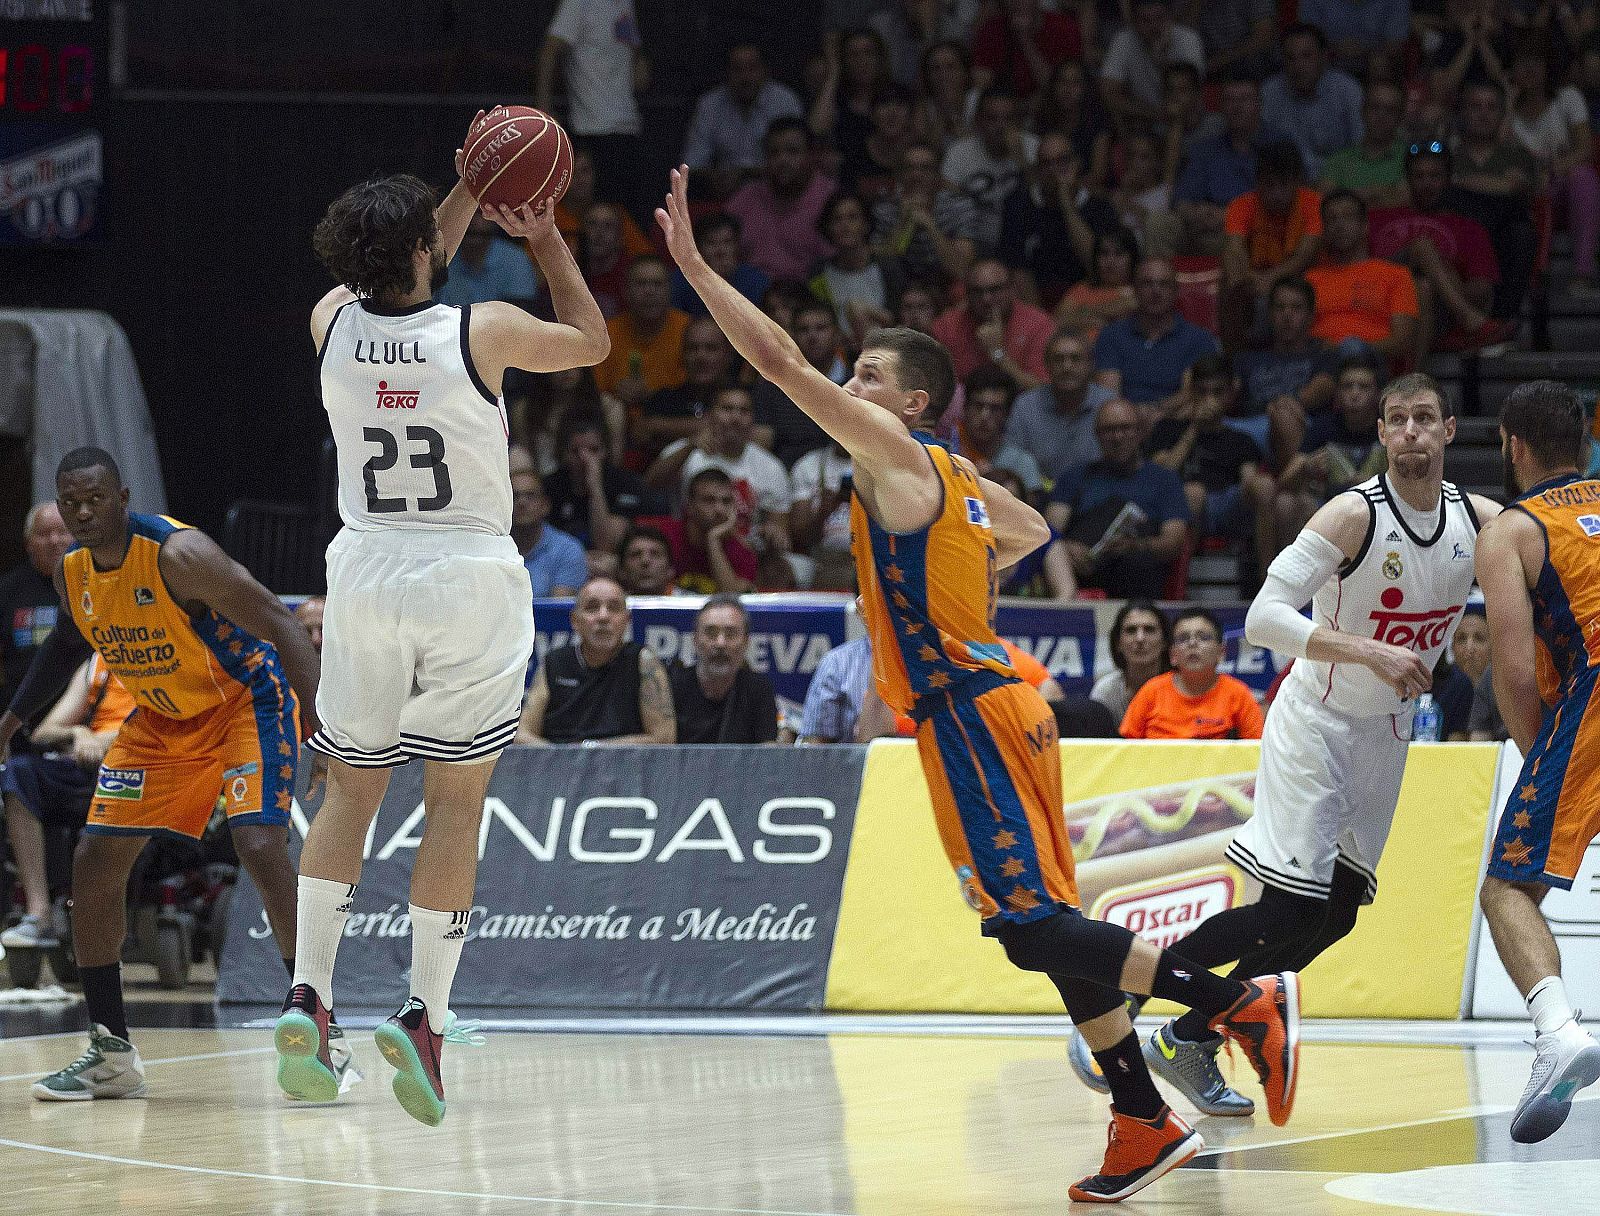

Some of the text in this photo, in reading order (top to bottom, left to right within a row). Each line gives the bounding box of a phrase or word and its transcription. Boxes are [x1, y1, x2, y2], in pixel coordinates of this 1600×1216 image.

[466, 123, 522, 186] SPALDING
[354, 339, 427, 364] LLULL
[362, 425, 453, 513] 23
[91, 624, 150, 645] Cultura
[101, 642, 176, 666] Esfuerzo
[140, 687, 180, 715] 10
[638, 915, 664, 940] a
[670, 902, 817, 941] Medida
[1125, 899, 1208, 933] Oscar
